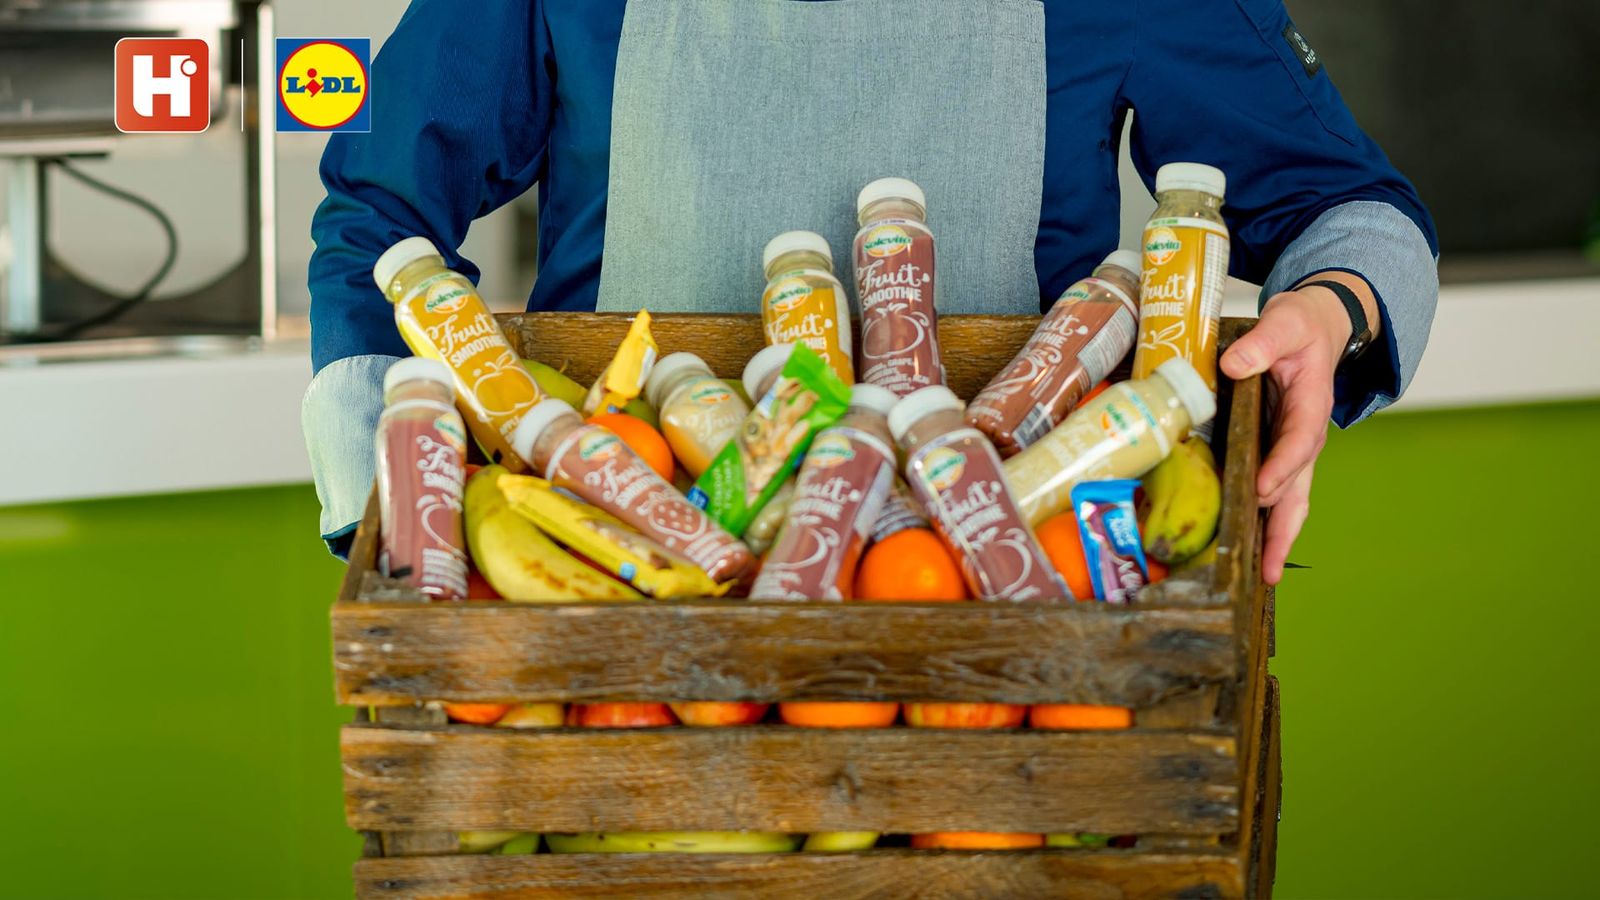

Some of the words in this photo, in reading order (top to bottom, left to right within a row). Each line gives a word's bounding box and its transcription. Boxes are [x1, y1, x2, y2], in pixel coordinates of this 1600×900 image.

[857, 259, 922, 298] Fruit
[863, 286, 923, 312] SMOOTHIE
[425, 313, 497, 358] Fruit
